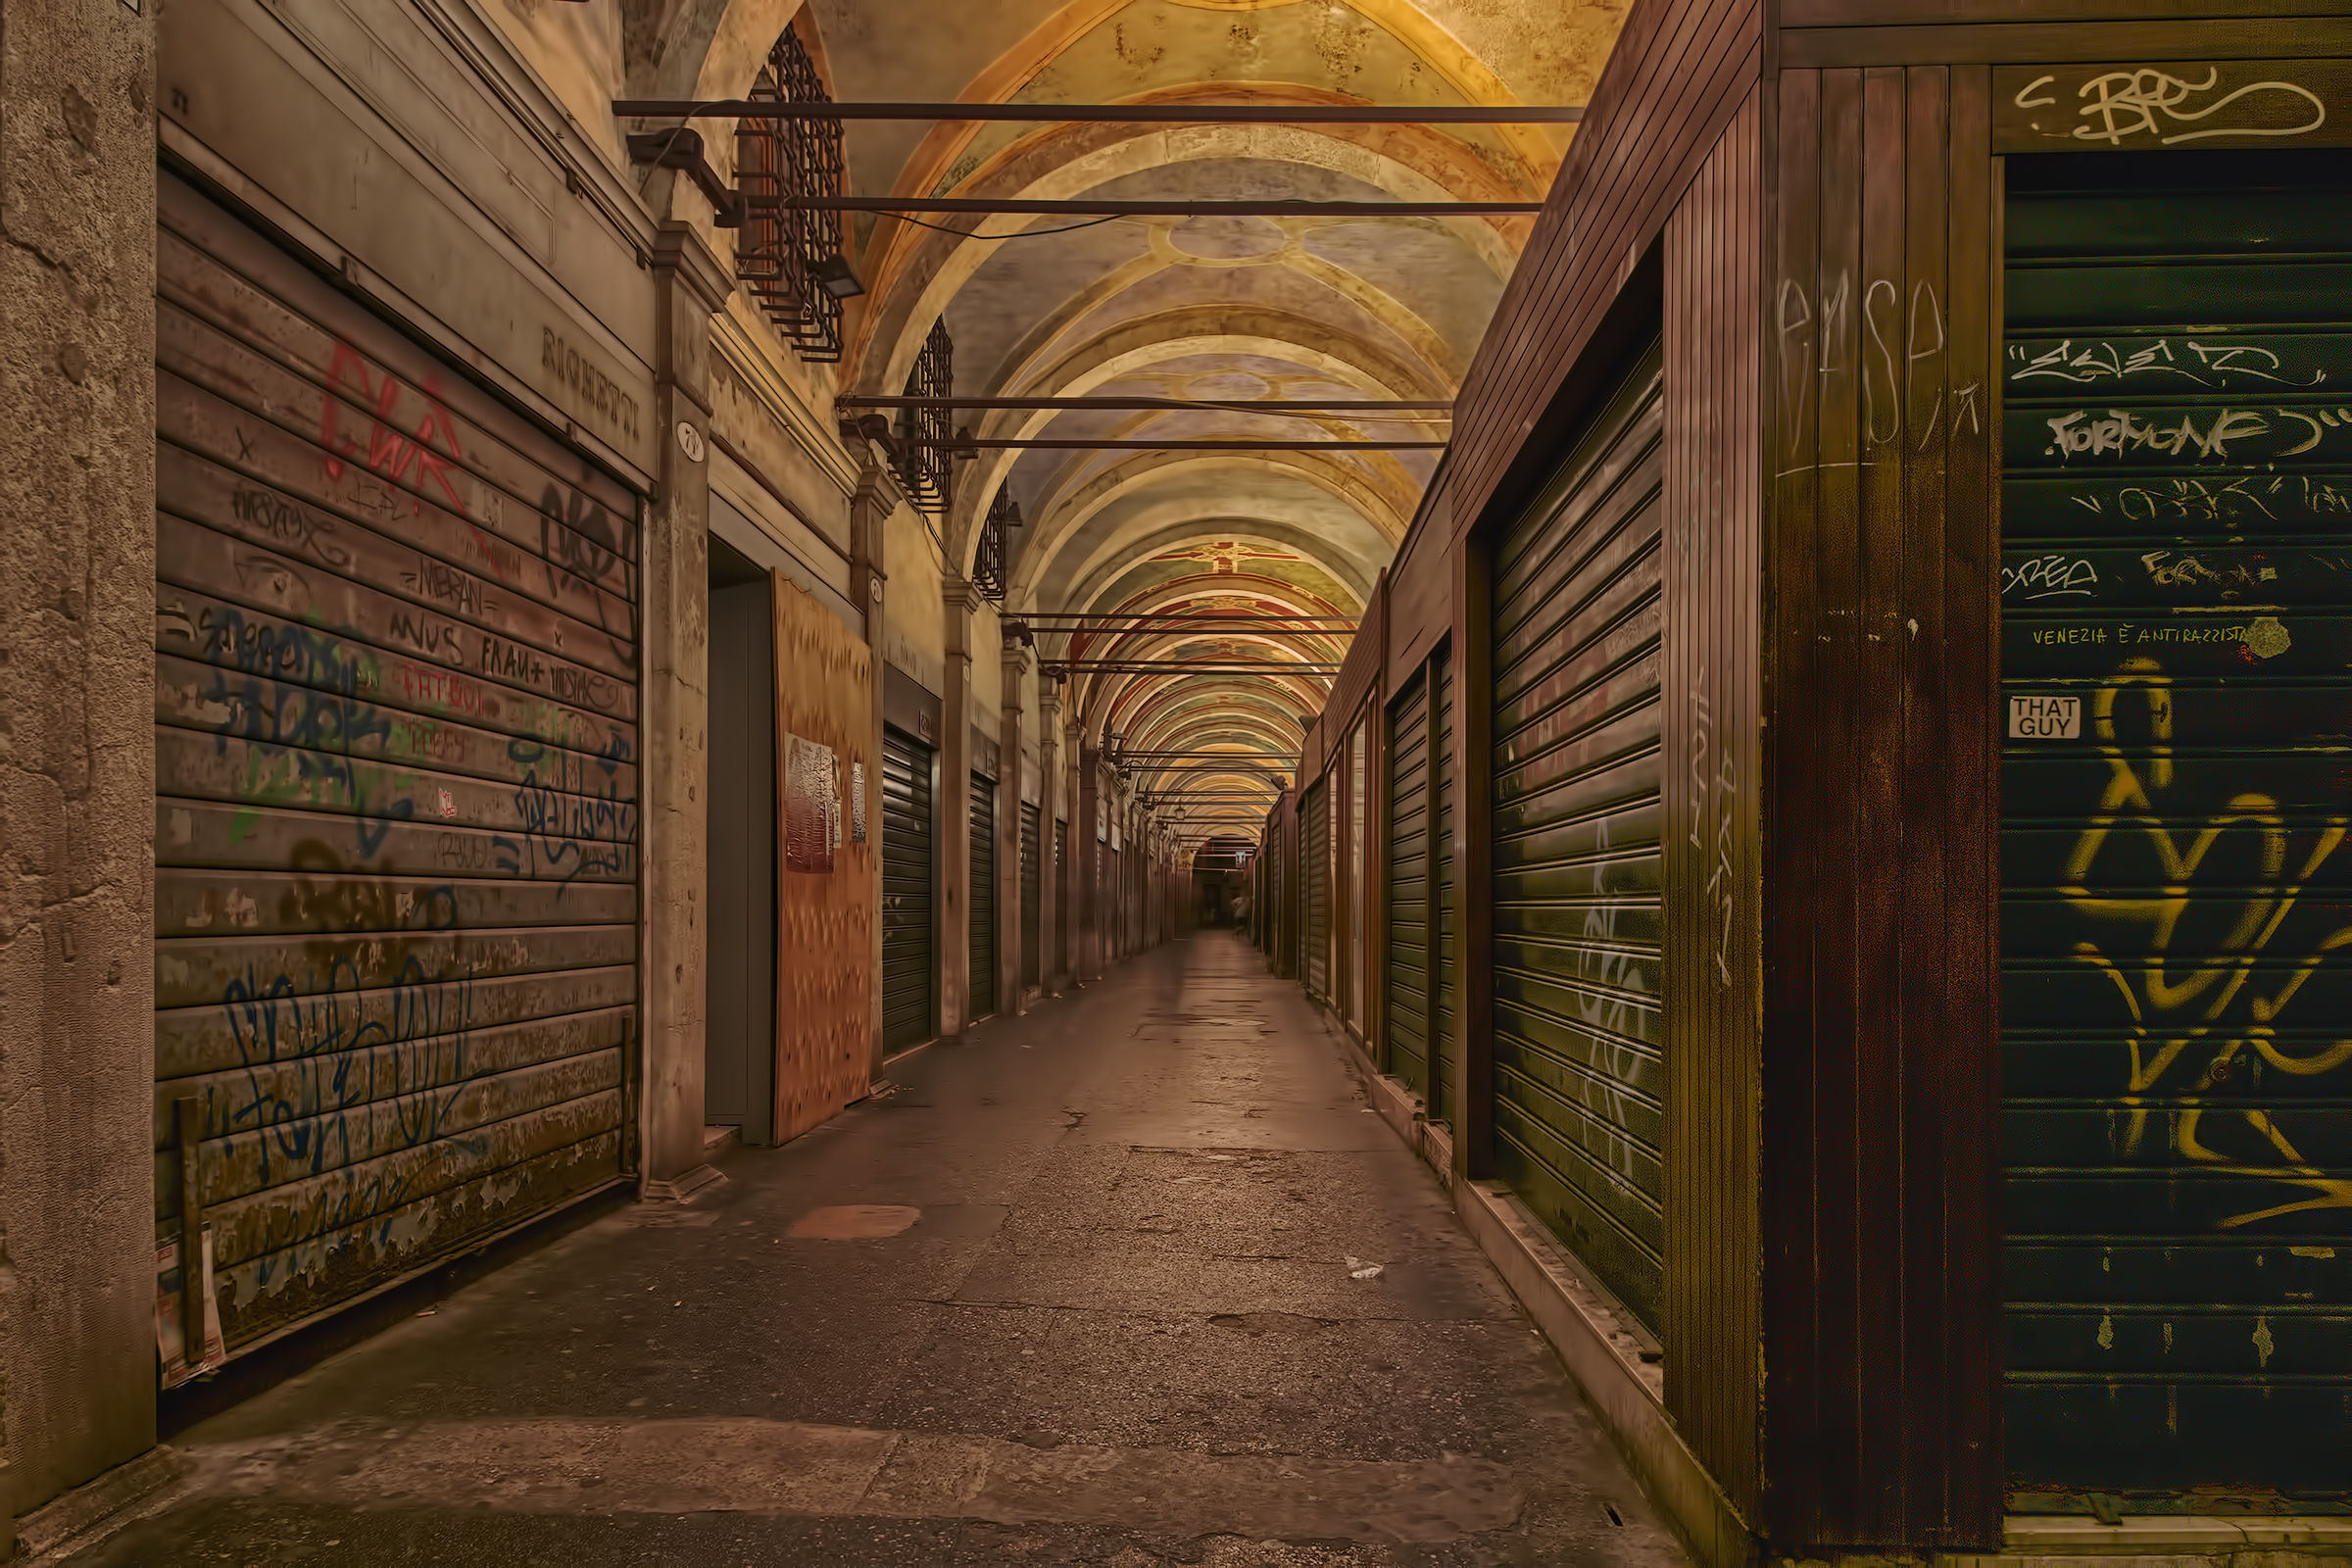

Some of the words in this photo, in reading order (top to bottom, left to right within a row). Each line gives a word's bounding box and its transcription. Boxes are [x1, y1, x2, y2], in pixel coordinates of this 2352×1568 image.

[2033, 627, 2107, 645] VENEZIA
[2013, 698, 2078, 717] THAT
[2019, 717, 2072, 737] GUY
